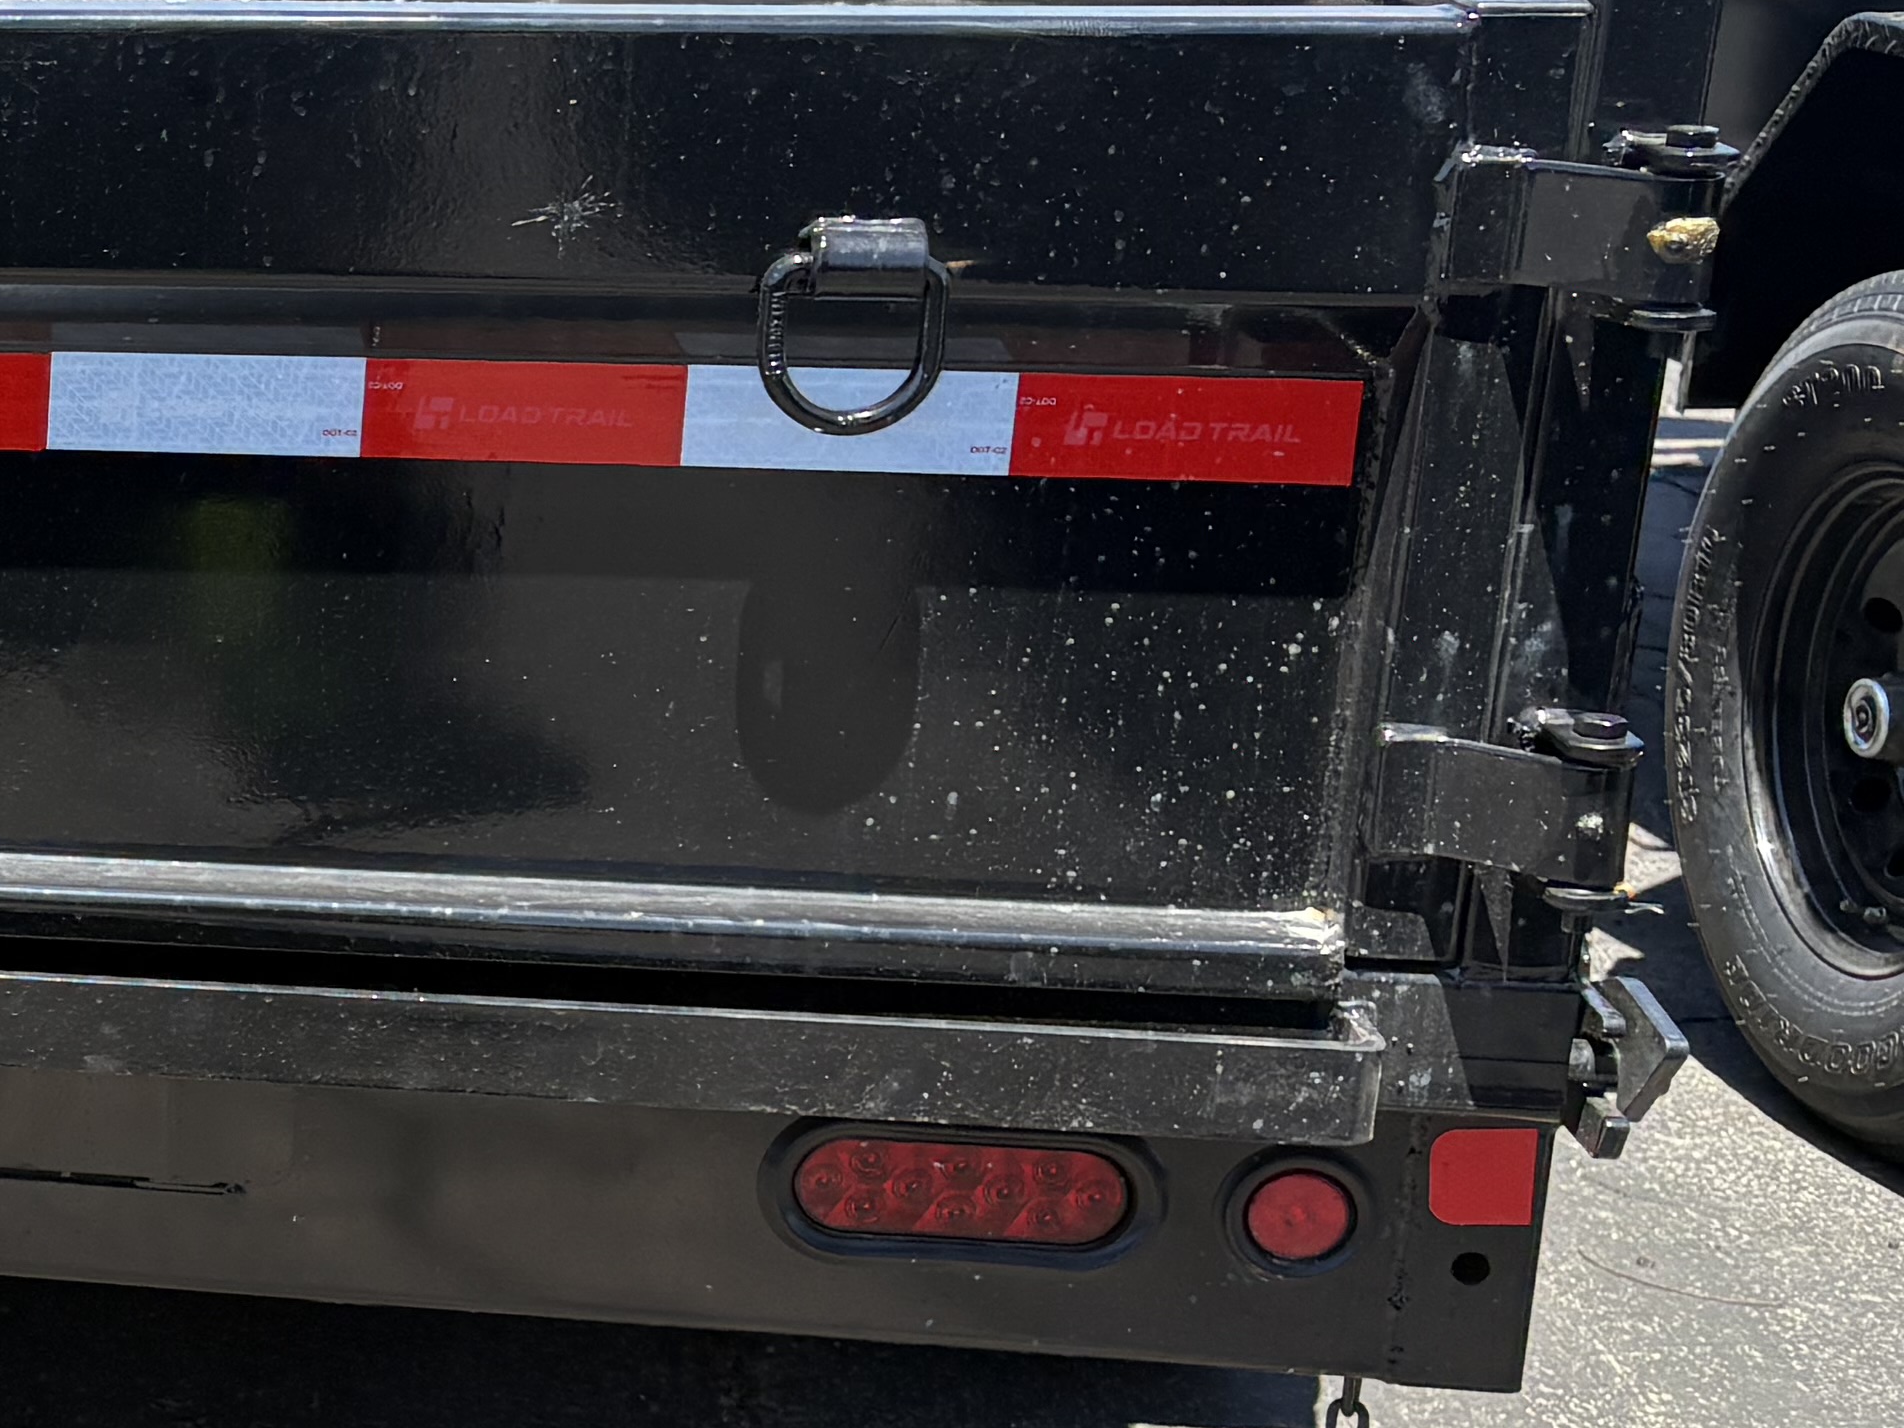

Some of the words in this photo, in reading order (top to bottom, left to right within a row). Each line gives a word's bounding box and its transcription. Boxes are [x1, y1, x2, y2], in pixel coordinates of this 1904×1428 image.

[459, 405, 541, 424] LOAD
[544, 407, 632, 427] TRAIL
[1112, 420, 1201, 441] LOAD
[1208, 422, 1301, 444] TRAIL
